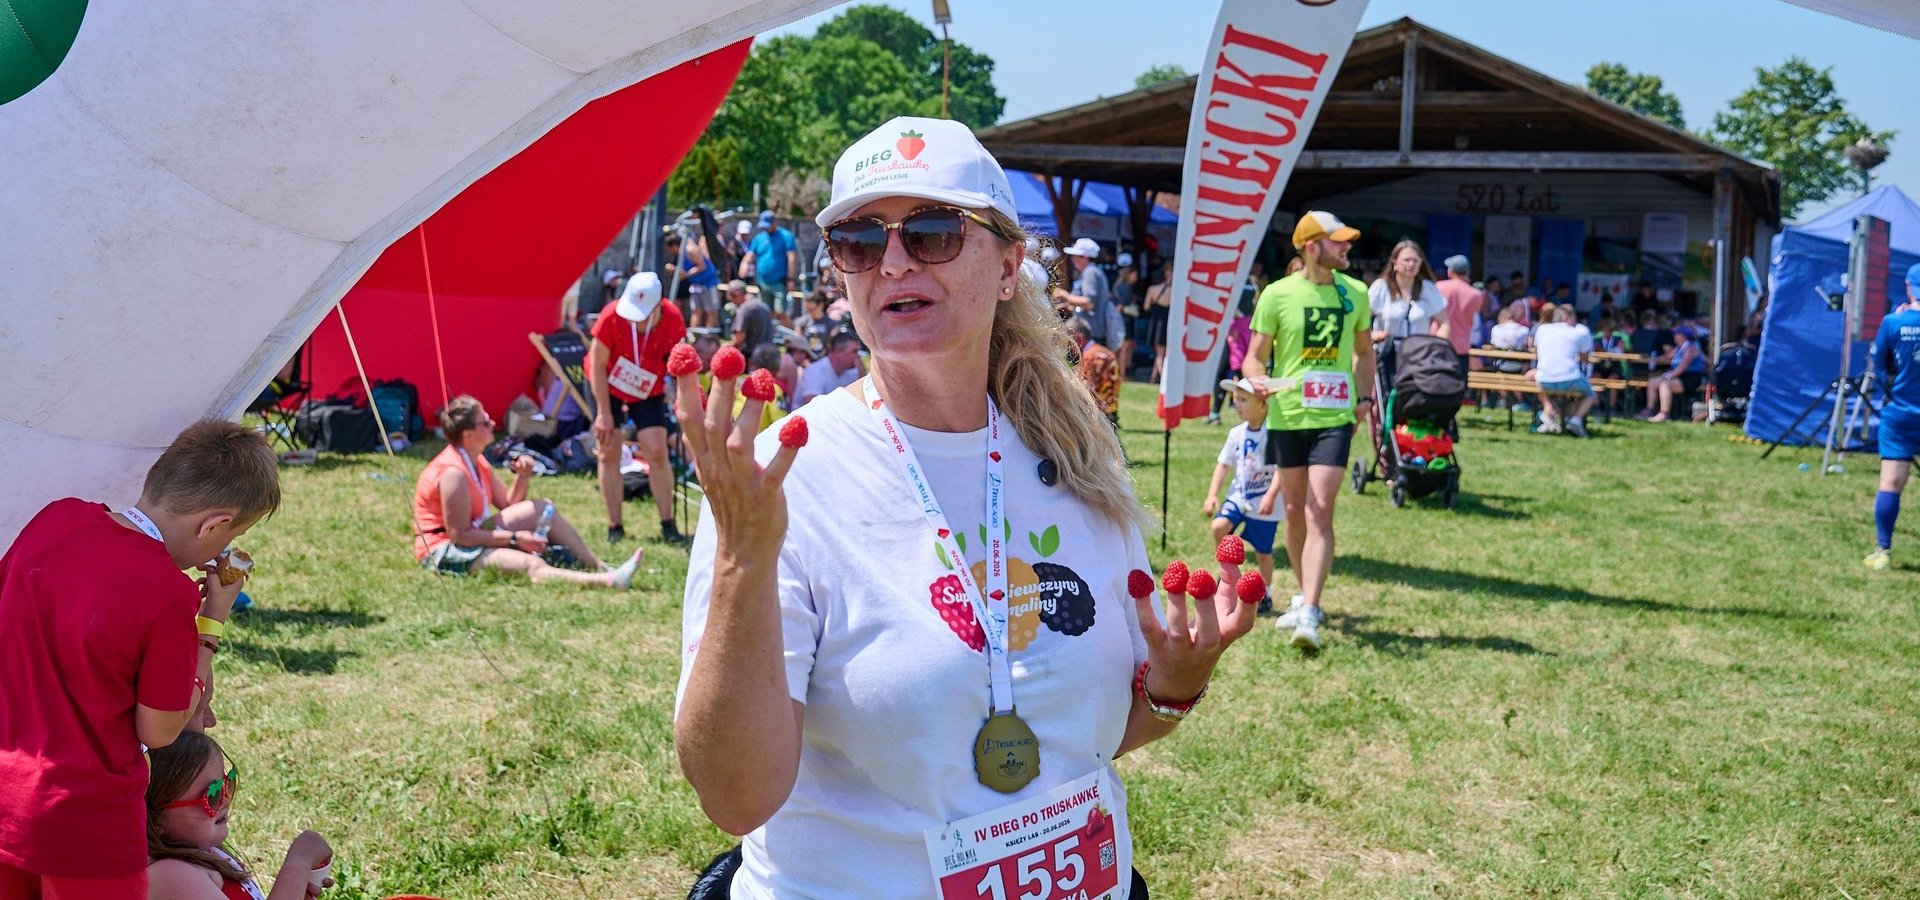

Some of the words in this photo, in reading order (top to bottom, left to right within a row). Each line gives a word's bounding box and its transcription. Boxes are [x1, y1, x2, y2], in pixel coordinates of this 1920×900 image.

[855, 149, 892, 172] BIEG
[1182, 24, 1328, 363] CZANIECKI
[1455, 183, 1506, 213] 520
[1310, 381, 1341, 397] 172
[883, 418, 905, 453] 20.06.2026
[950, 549, 972, 587] 20.06.2026
[992, 539, 1001, 577] 20.06.2026
[942, 586, 970, 607] Sup
[983, 580, 1079, 597] iewczyny
[974, 828, 987, 843] IV
[990, 819, 1020, 839] BIEG
[1022, 813, 1039, 828] PO
[1040, 785, 1100, 820] TRUSKAWKĘ
[1027, 832, 1039, 842] LAS
[1042, 818, 1071, 835] 20.06.2026
[976, 834, 1085, 900] 155
